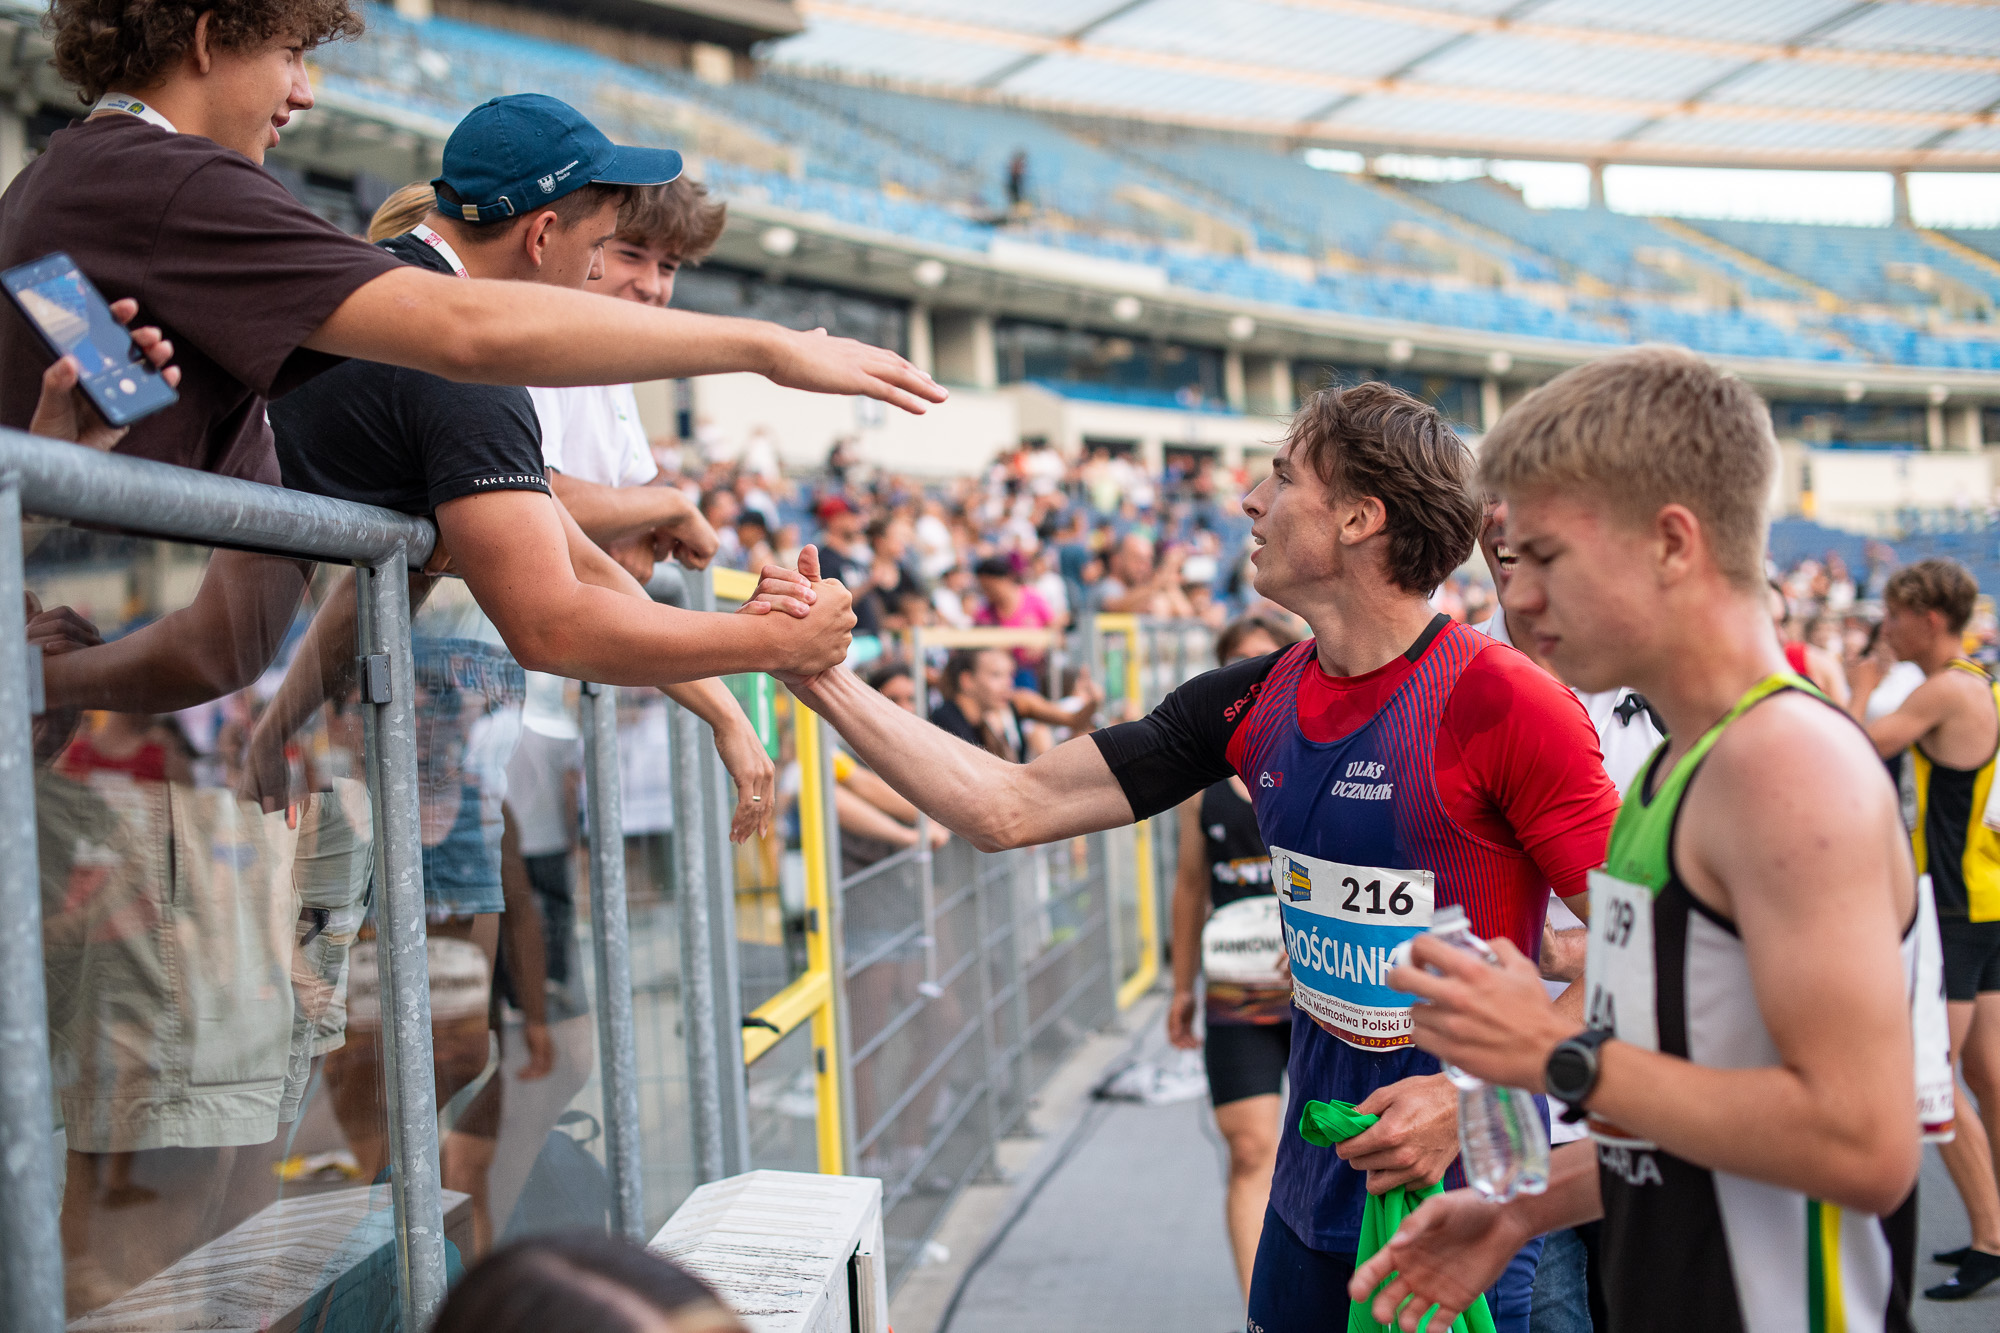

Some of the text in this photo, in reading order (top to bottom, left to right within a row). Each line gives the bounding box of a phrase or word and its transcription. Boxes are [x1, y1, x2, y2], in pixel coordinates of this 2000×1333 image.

[474, 476, 505, 486] TAKE
[517, 475, 539, 484] DEEP
[1223, 681, 1266, 722] SPEE
[1345, 760, 1385, 780] ULKS
[1331, 780, 1394, 801] UCZNIAK
[1341, 876, 1415, 916] 216
[1313, 1000, 1359, 1028] Mistrzostwa
[1362, 1018, 1400, 1031] Polski
